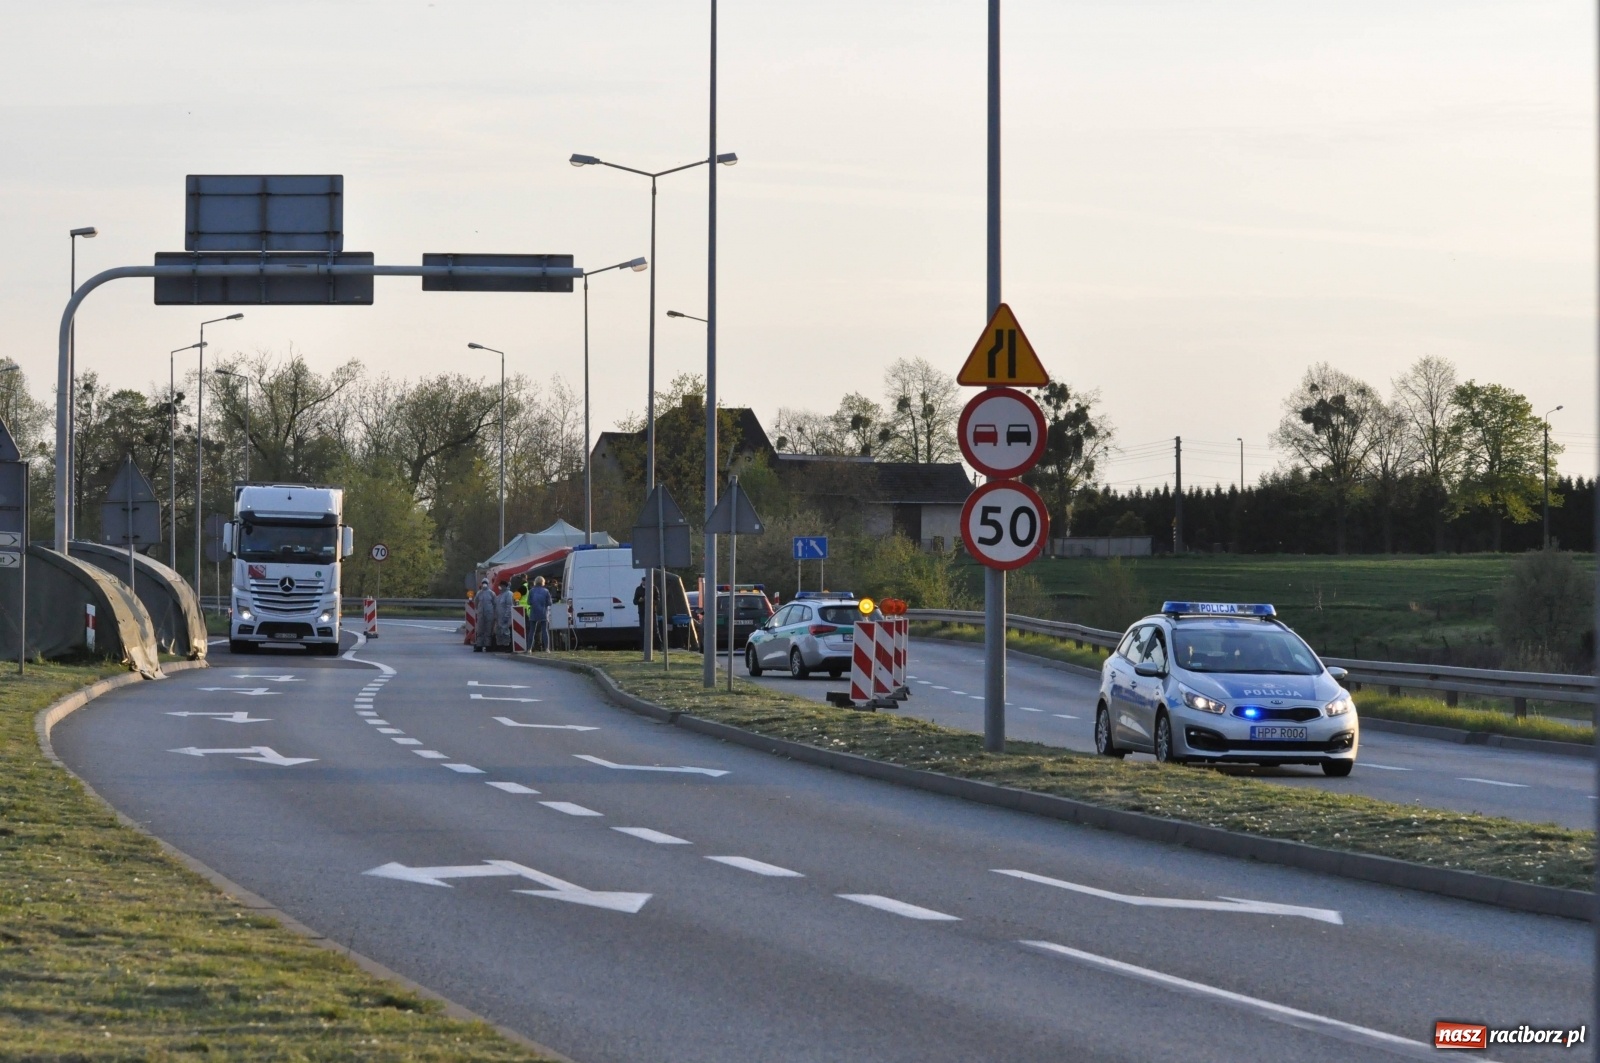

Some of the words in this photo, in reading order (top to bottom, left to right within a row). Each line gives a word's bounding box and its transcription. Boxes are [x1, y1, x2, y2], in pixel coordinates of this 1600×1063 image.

[977, 505, 1037, 548] 50
[374, 547, 387, 557] 70
[1200, 603, 1236, 613] POLICJA
[1243, 689, 1303, 698] POLICJA
[1257, 727, 1277, 738] HPP
[1280, 728, 1304, 739] R006
